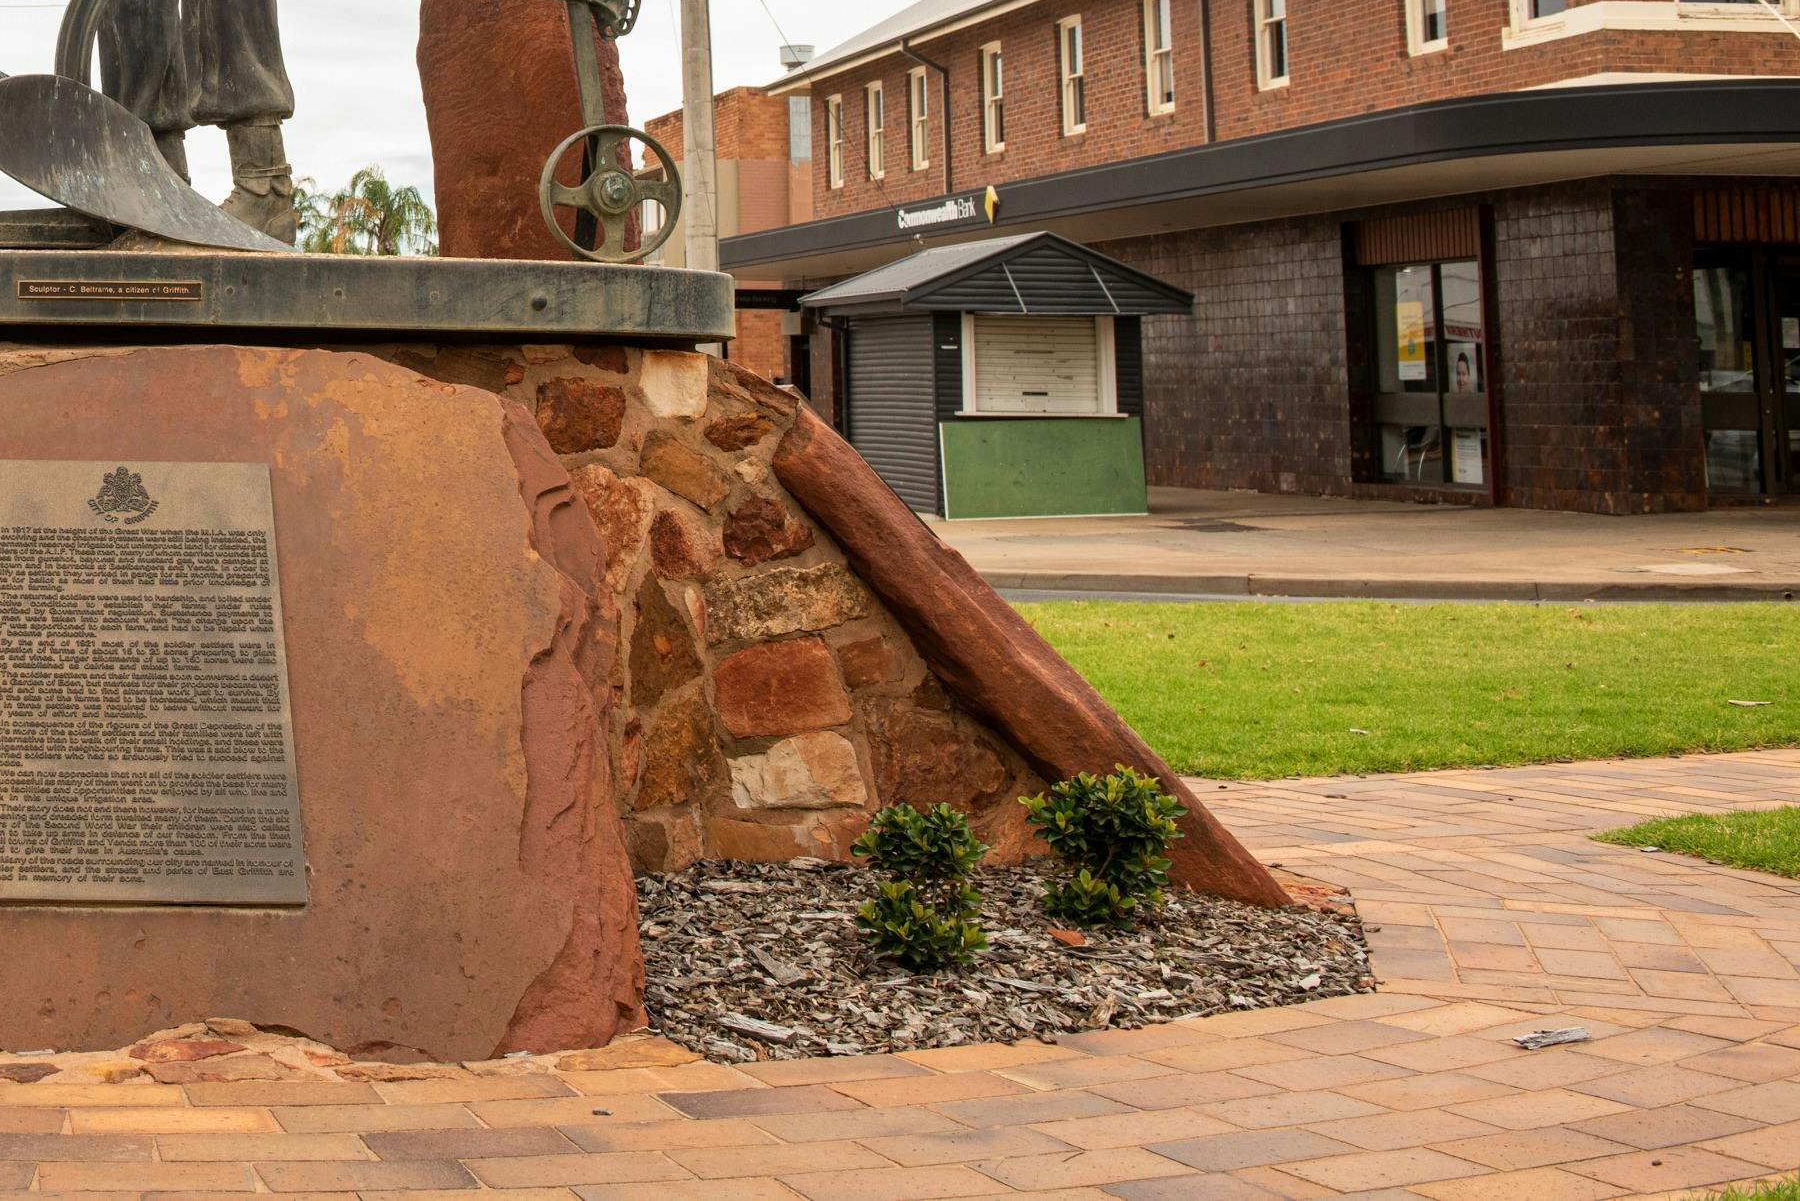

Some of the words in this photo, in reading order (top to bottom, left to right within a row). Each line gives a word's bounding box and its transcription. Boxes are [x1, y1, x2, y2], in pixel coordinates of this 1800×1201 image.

[29, 285, 60, 294] Sculptor
[125, 286, 150, 294] citizen
[87, 499, 105, 516] CITY
[43, 526, 57, 534] the
[59, 526, 86, 535] height
[140, 527, 158, 535] War
[159, 527, 183, 535] when
[246, 528, 266, 537] only
[29, 547, 43, 555] the
[96, 549, 118, 557] men,
[145, 548, 154, 556] of
[155, 548, 181, 556] whom
[215, 549, 249, 557] wounds
[250, 549, 267, 557] and
[19, 592, 58, 600] returned
[59, 592, 95, 600] soldiers
[120, 593, 142, 601] used
[143, 593, 153, 601] to
[154, 593, 196, 603] hardship,
[217, 594, 243, 602] toiled
[244, 594, 271, 602] under
[0, 638, 12, 647] By
[18, 638, 33, 646] the
[37, 638, 55, 646] end
[101, 639, 124, 647] most
[129, 639, 139, 647] of
[143, 639, 158, 647] the
[163, 640, 195, 648] soldier
[200, 640, 234, 648] settlers
[0, 670, 18, 678] The
[19, 670, 51, 678] soldier
[53, 671, 87, 679] settlers
[89, 671, 106, 679] and
[108, 671, 130, 679] their
[131, 671, 167, 680] families
[248, 672, 278, 681] desert
[9, 678, 44, 686] Garden
[45, 678, 55, 686] of
[57, 678, 83, 688] Eden,
[85, 679, 101, 687] but
[103, 679, 140, 687] markets
[141, 679, 155, 687] for
[157, 679, 178, 687] their
[180, 679, 219, 689] produce
[220, 680, 257, 688] became
[258, 682, 279, 690] very
[0, 769, 15, 777] We
[58, 769, 109, 779] appreciate
[110, 770, 129, 778] that
[131, 770, 147, 778] not
[148, 770, 160, 778] all
[162, 770, 172, 779] of
[174, 770, 189, 779] the
[191, 770, 224, 779] soldier
[225, 771, 261, 779] settlers
[11, 820, 21, 828] of
[24, 820, 40, 829] the
[44, 820, 80, 829] Second
[84, 820, 112, 829] World
[117, 821, 136, 829] War
[140, 821, 162, 830] their
[166, 821, 205, 830] children
[237, 822, 256, 830] also
[260, 822, 290, 831] called
[8, 837, 37, 845] towns
[38, 837, 48, 845] of
[50, 837, 85, 846] Griffith
[87, 837, 104, 846] and
[165, 838, 187, 847] than
[207, 838, 218, 847] of
[219, 838, 242, 847] their
[0, 855, 26, 866] Many
[28, 856, 38, 864] of
[39, 856, 55, 865] the
[56, 856, 84, 865] roads
[85, 856, 145, 867] surrounding
[164, 857, 183, 867] city
[201, 857, 234, 866] named
[235, 857, 244, 866] in
[282, 858, 293, 866] of
[18, 864, 58, 875] settlers,
[61, 864, 80, 873] and
[85, 865, 101, 874] the
[104, 865, 138, 874] streets
[142, 865, 161, 874] and
[165, 865, 193, 876] parks
[197, 866, 208, 874] of
[211, 866, 233, 875] East
[237, 866, 273, 875] Griffith
